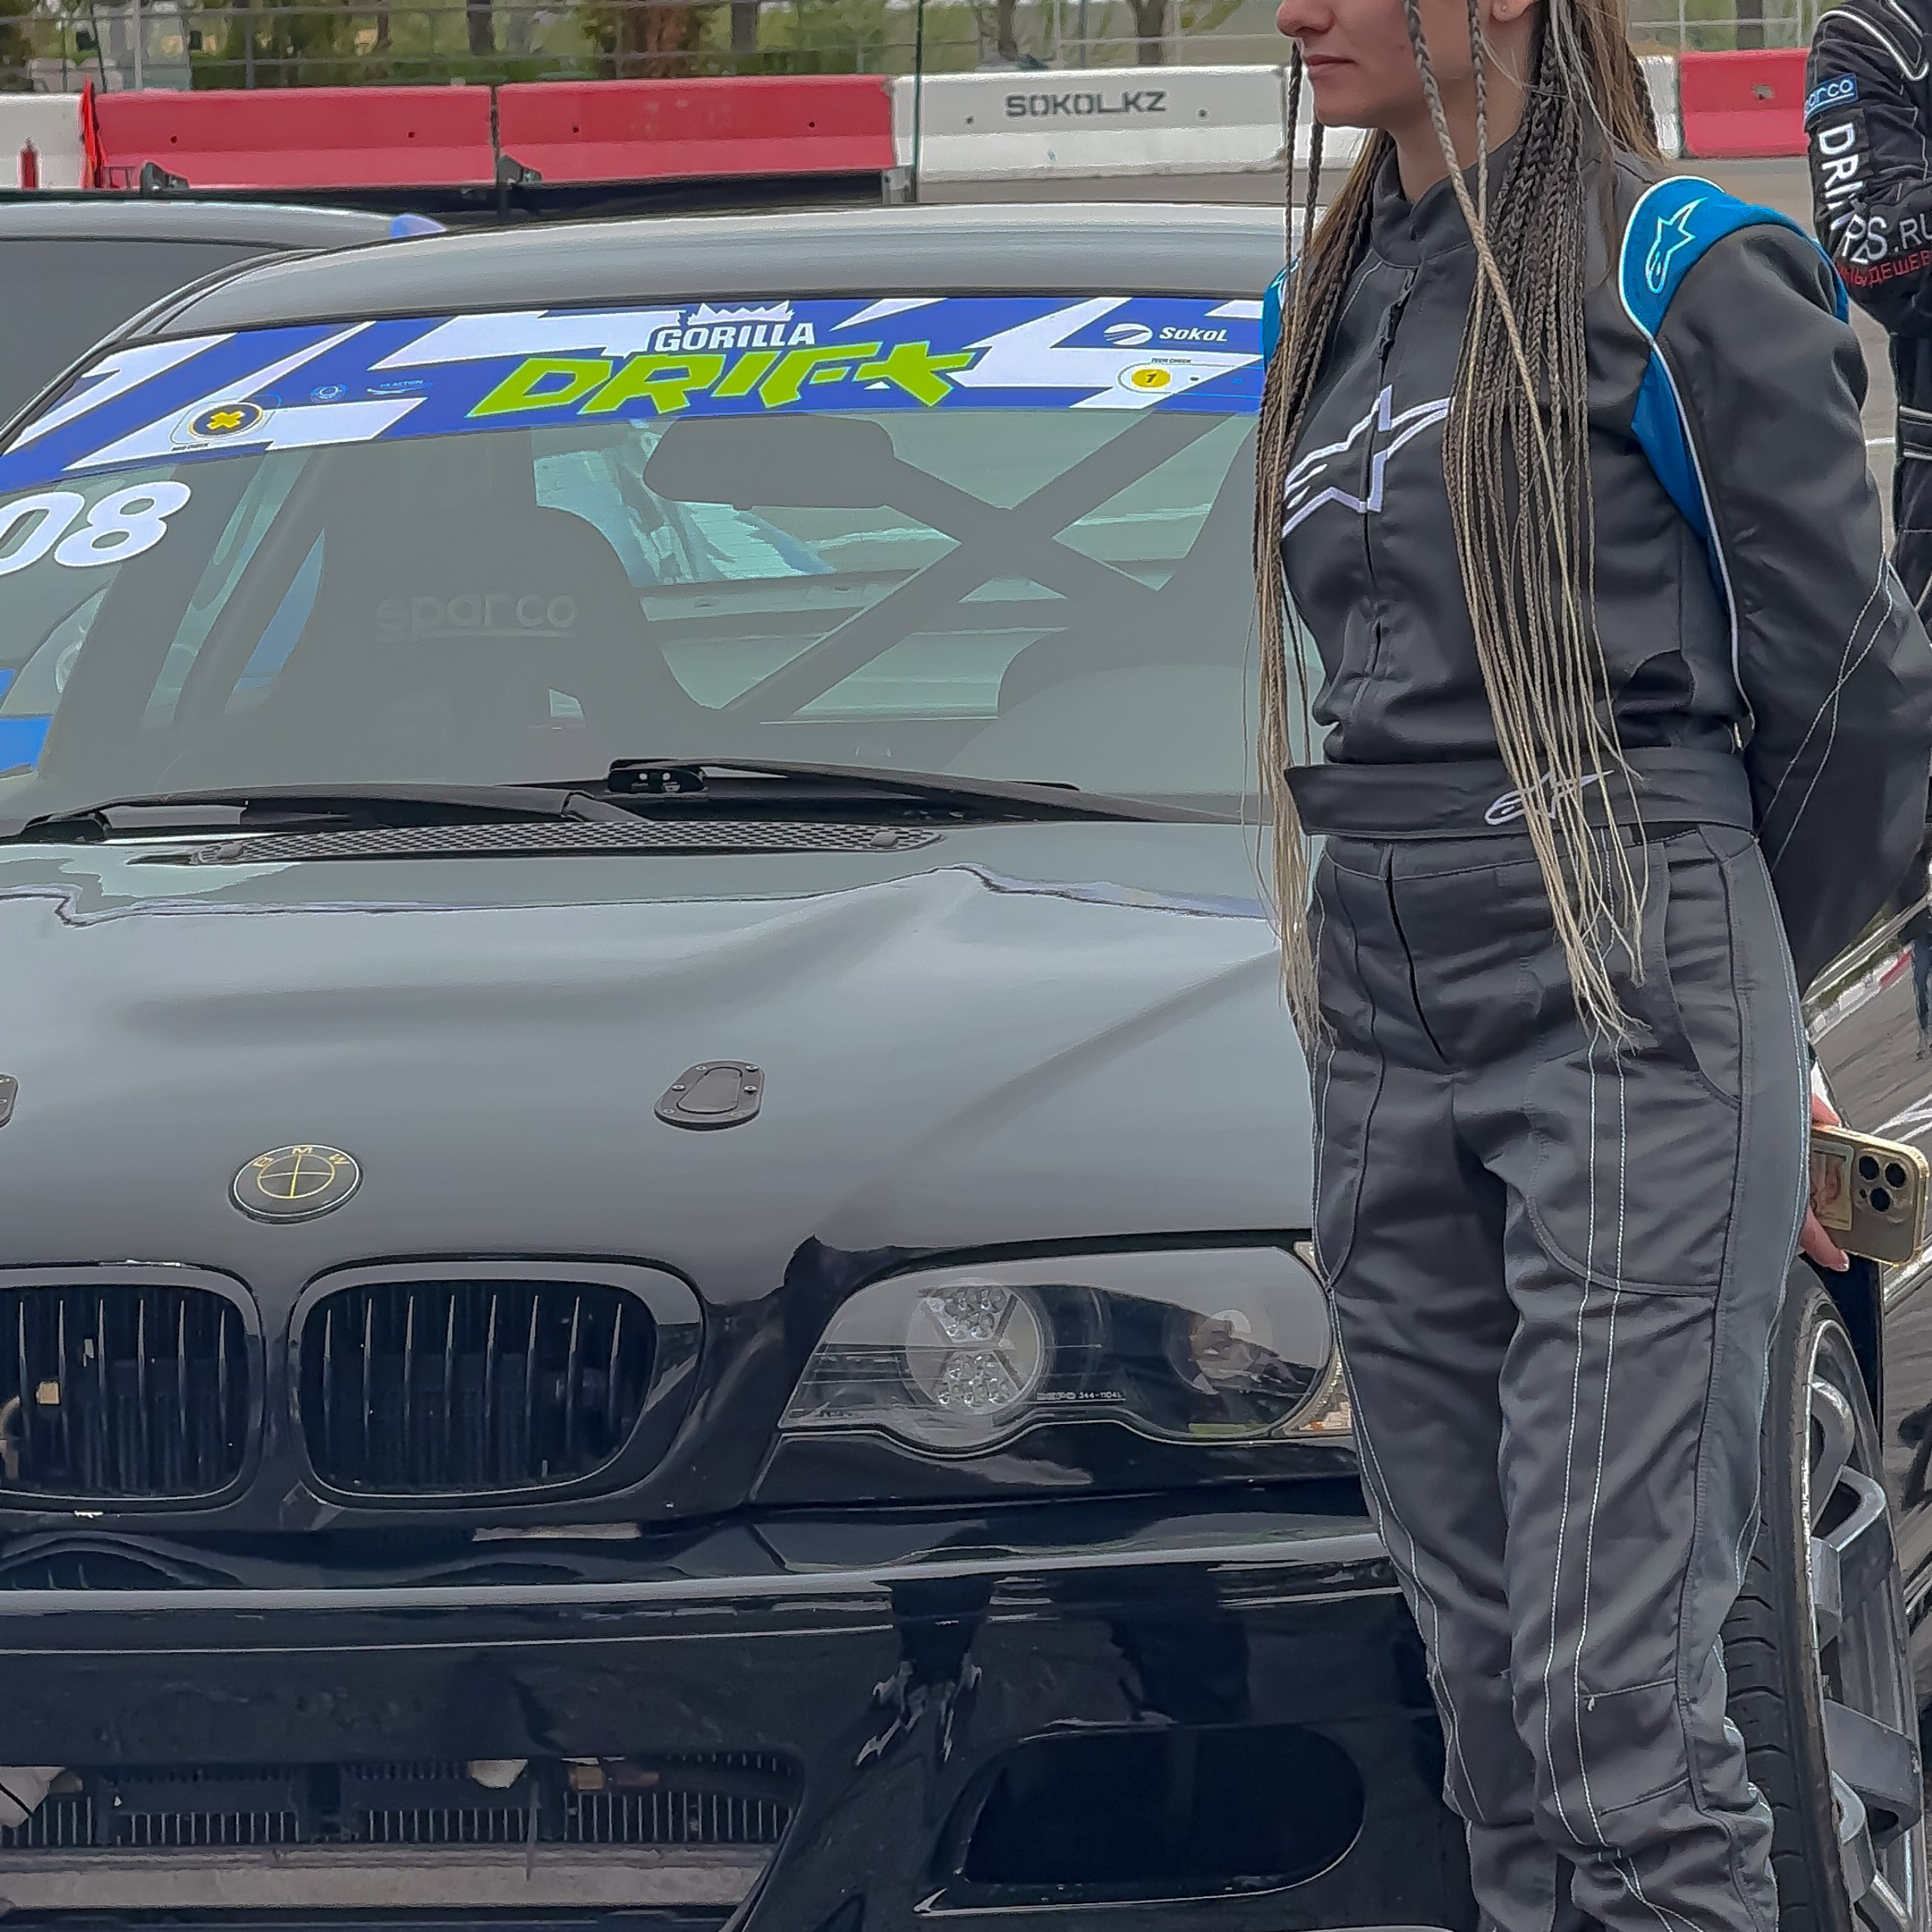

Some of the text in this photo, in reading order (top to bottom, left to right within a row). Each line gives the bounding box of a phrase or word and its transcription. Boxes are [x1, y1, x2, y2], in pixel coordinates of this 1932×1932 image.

[655, 322, 816, 352] GORILLA
[465, 340, 976, 418] DRIFT
[0, 481, 192, 576] 08
[376, 593, 578, 641] sparco
[252, 1146, 352, 1168] BMW
